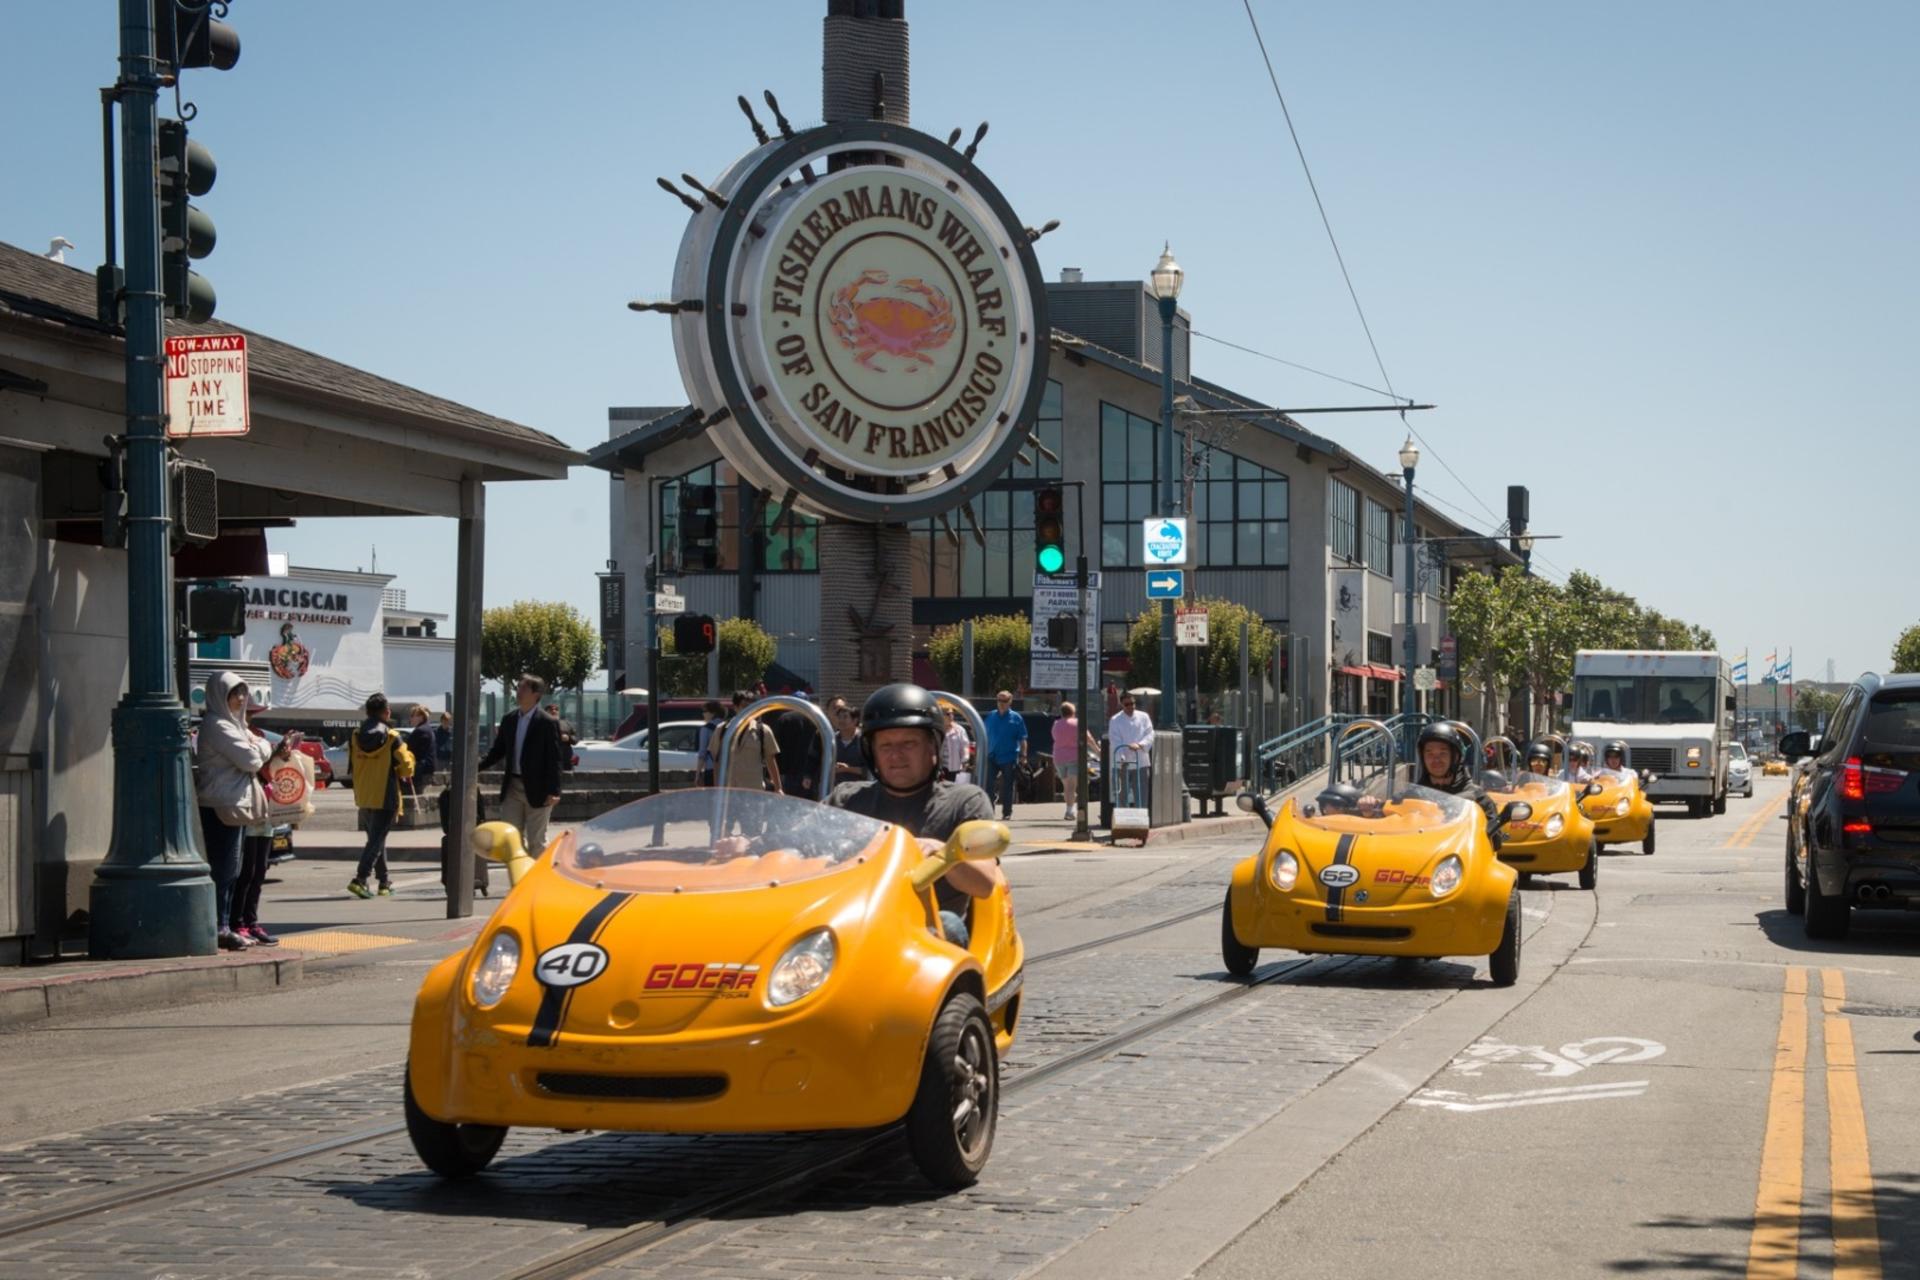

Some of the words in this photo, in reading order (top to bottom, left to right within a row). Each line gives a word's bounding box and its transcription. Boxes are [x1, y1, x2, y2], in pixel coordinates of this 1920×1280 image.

[773, 185, 939, 317] FISHERMANS
[937, 210, 1006, 337] WHARF
[170, 337, 240, 352] TOW-AWAY
[167, 353, 188, 377] NO
[191, 356, 242, 375] STOPPING
[190, 379, 222, 397] ANY
[776, 334, 815, 377] OF
[800, 382, 862, 444] SAN
[863, 351, 1004, 459] FRANCISCO
[187, 399, 226, 417] TIME
[231, 584, 348, 612] RANCISCAN
[1048, 599, 1078, 607] PARKIN
[703, 623, 713, 645] 9
[1323, 870, 1353, 883] 52
[542, 950, 600, 978] 40
